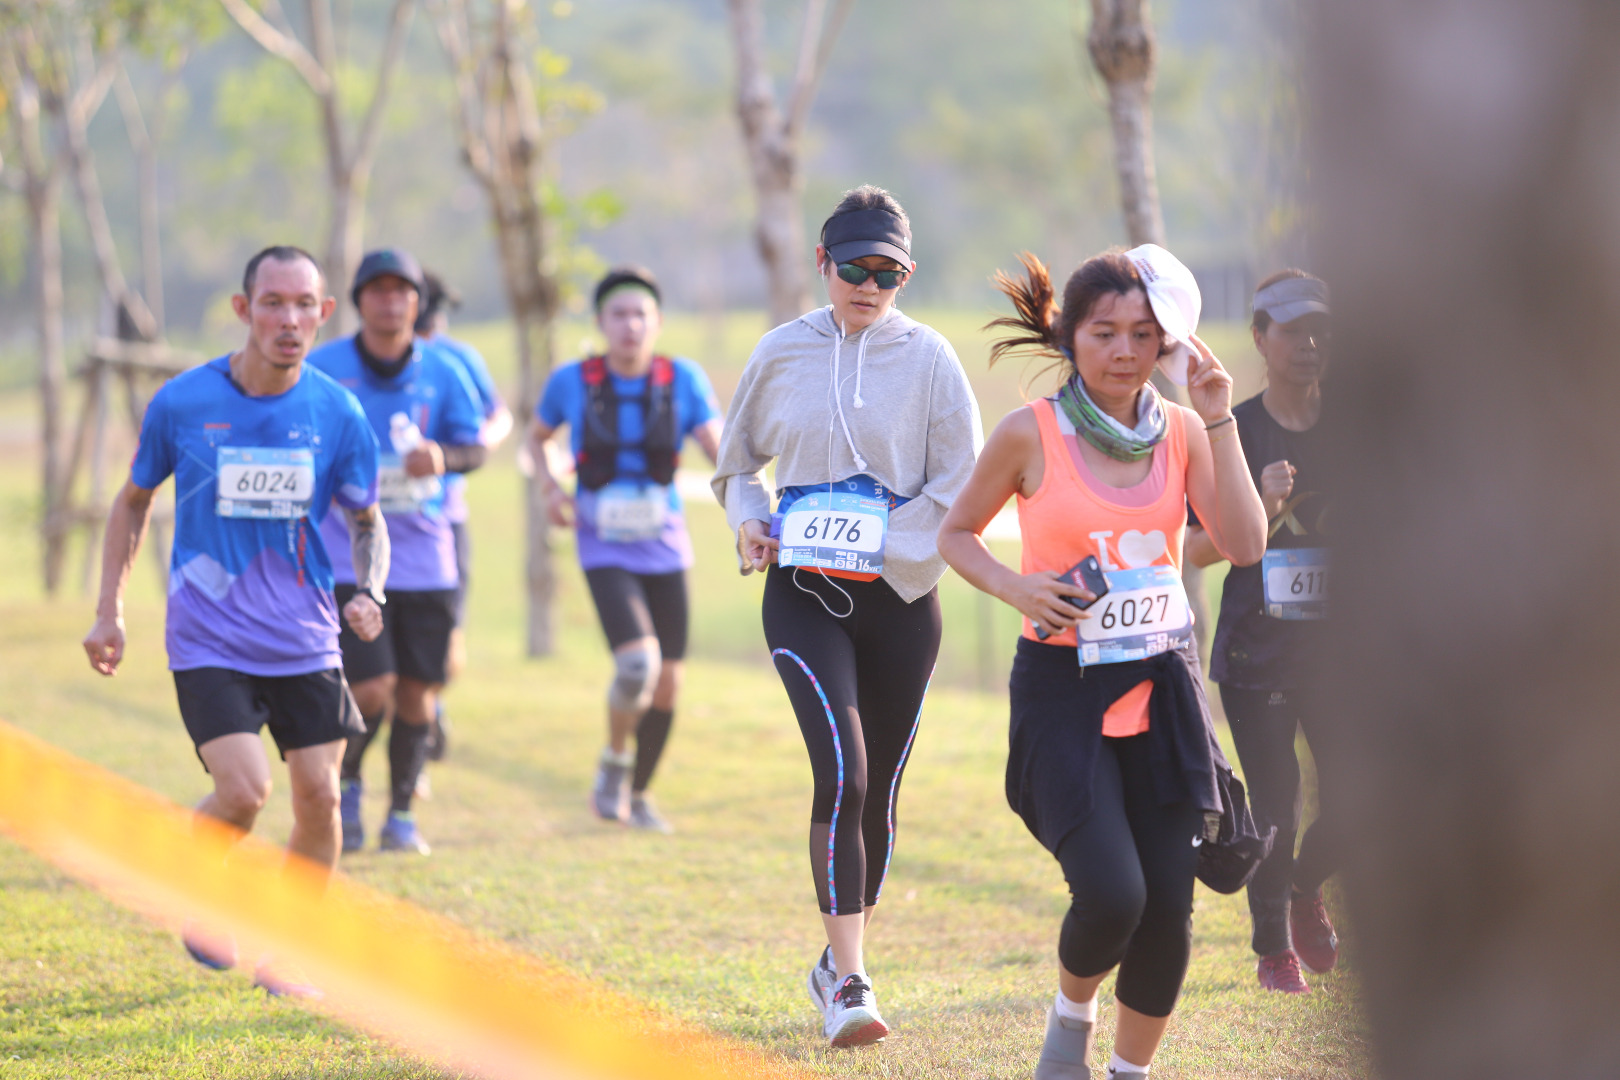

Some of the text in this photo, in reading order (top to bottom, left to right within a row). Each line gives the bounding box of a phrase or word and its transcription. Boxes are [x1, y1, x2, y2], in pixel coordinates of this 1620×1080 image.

[236, 470, 298, 493] 6024
[803, 516, 862, 543] 6176
[1088, 530, 1119, 571] I
[1290, 571, 1324, 595] 611
[1101, 593, 1169, 630] 6027
